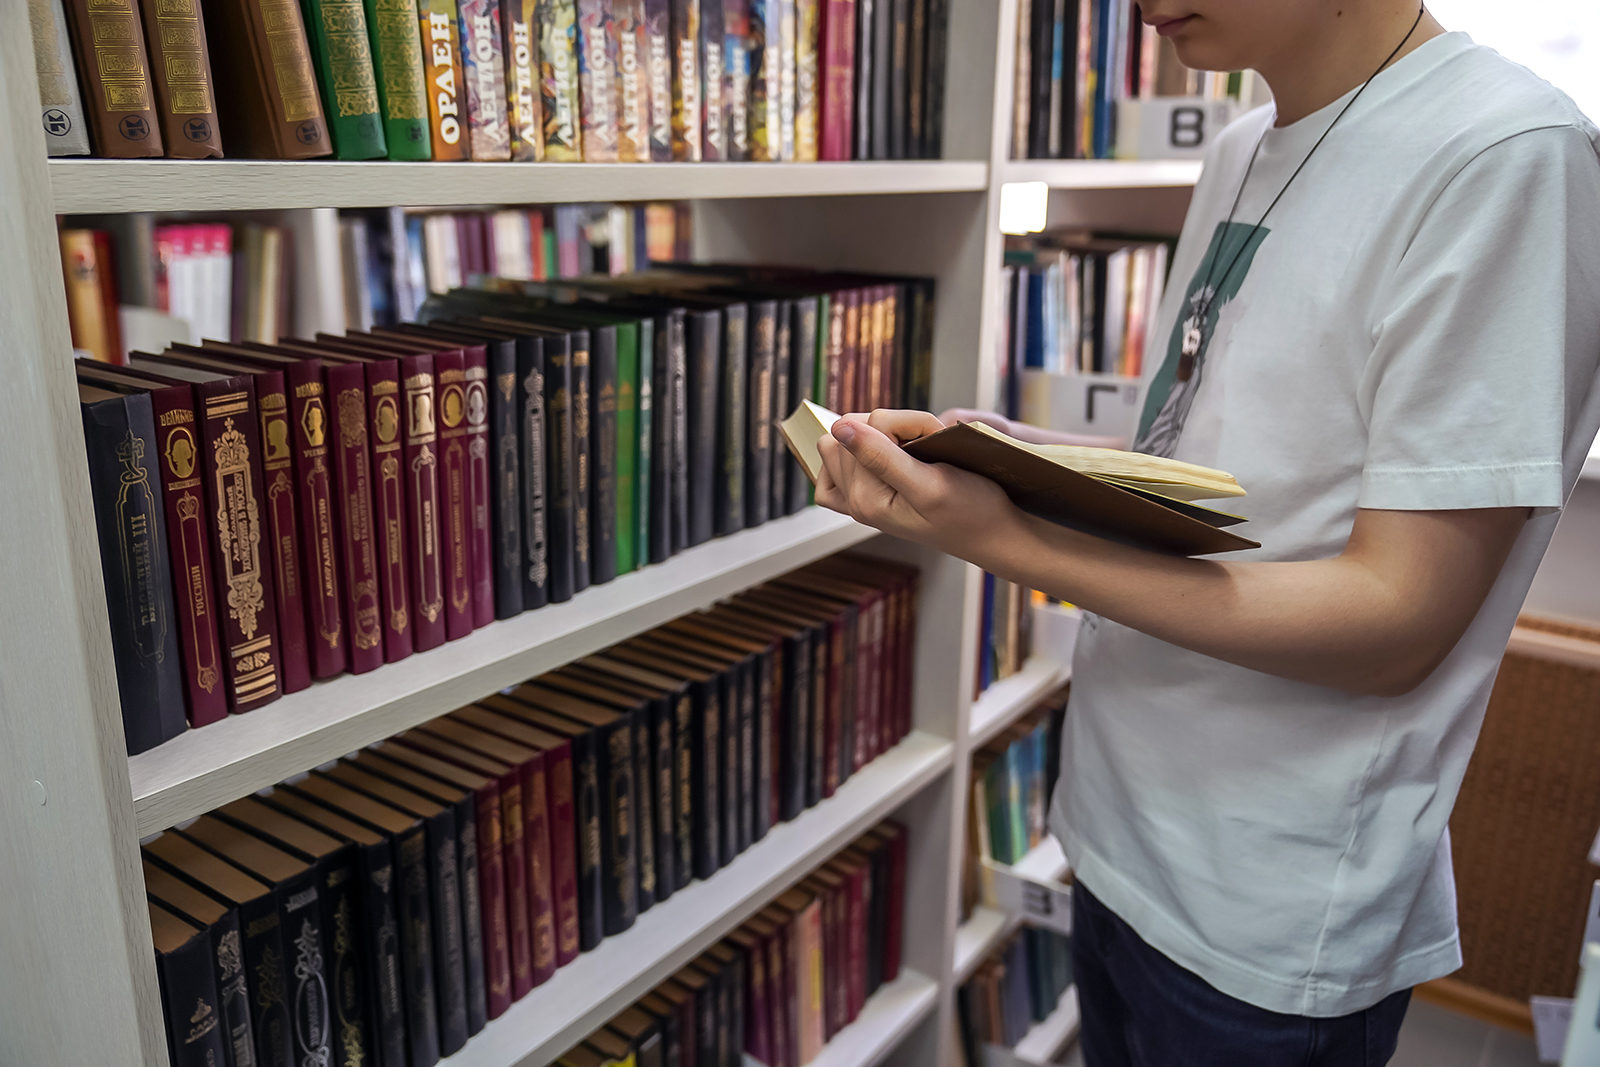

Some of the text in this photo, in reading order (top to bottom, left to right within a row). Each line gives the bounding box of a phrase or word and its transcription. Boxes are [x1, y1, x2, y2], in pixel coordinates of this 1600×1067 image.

[429, 12, 461, 145] ОРДЕН
[474, 15, 502, 144] ЛЕГИОН
[513, 21, 536, 146] ЛЕГИОН
[552, 27, 574, 147] ЛЕГИОН
[590, 27, 609, 145] ЛЕГИОН
[1170, 106, 1204, 147] В
[1086, 384, 1118, 423] Г
[130, 513, 147, 537] III
[234, 472, 245, 510] МОСКВУ
[190, 565, 205, 616] РОССИНИ
